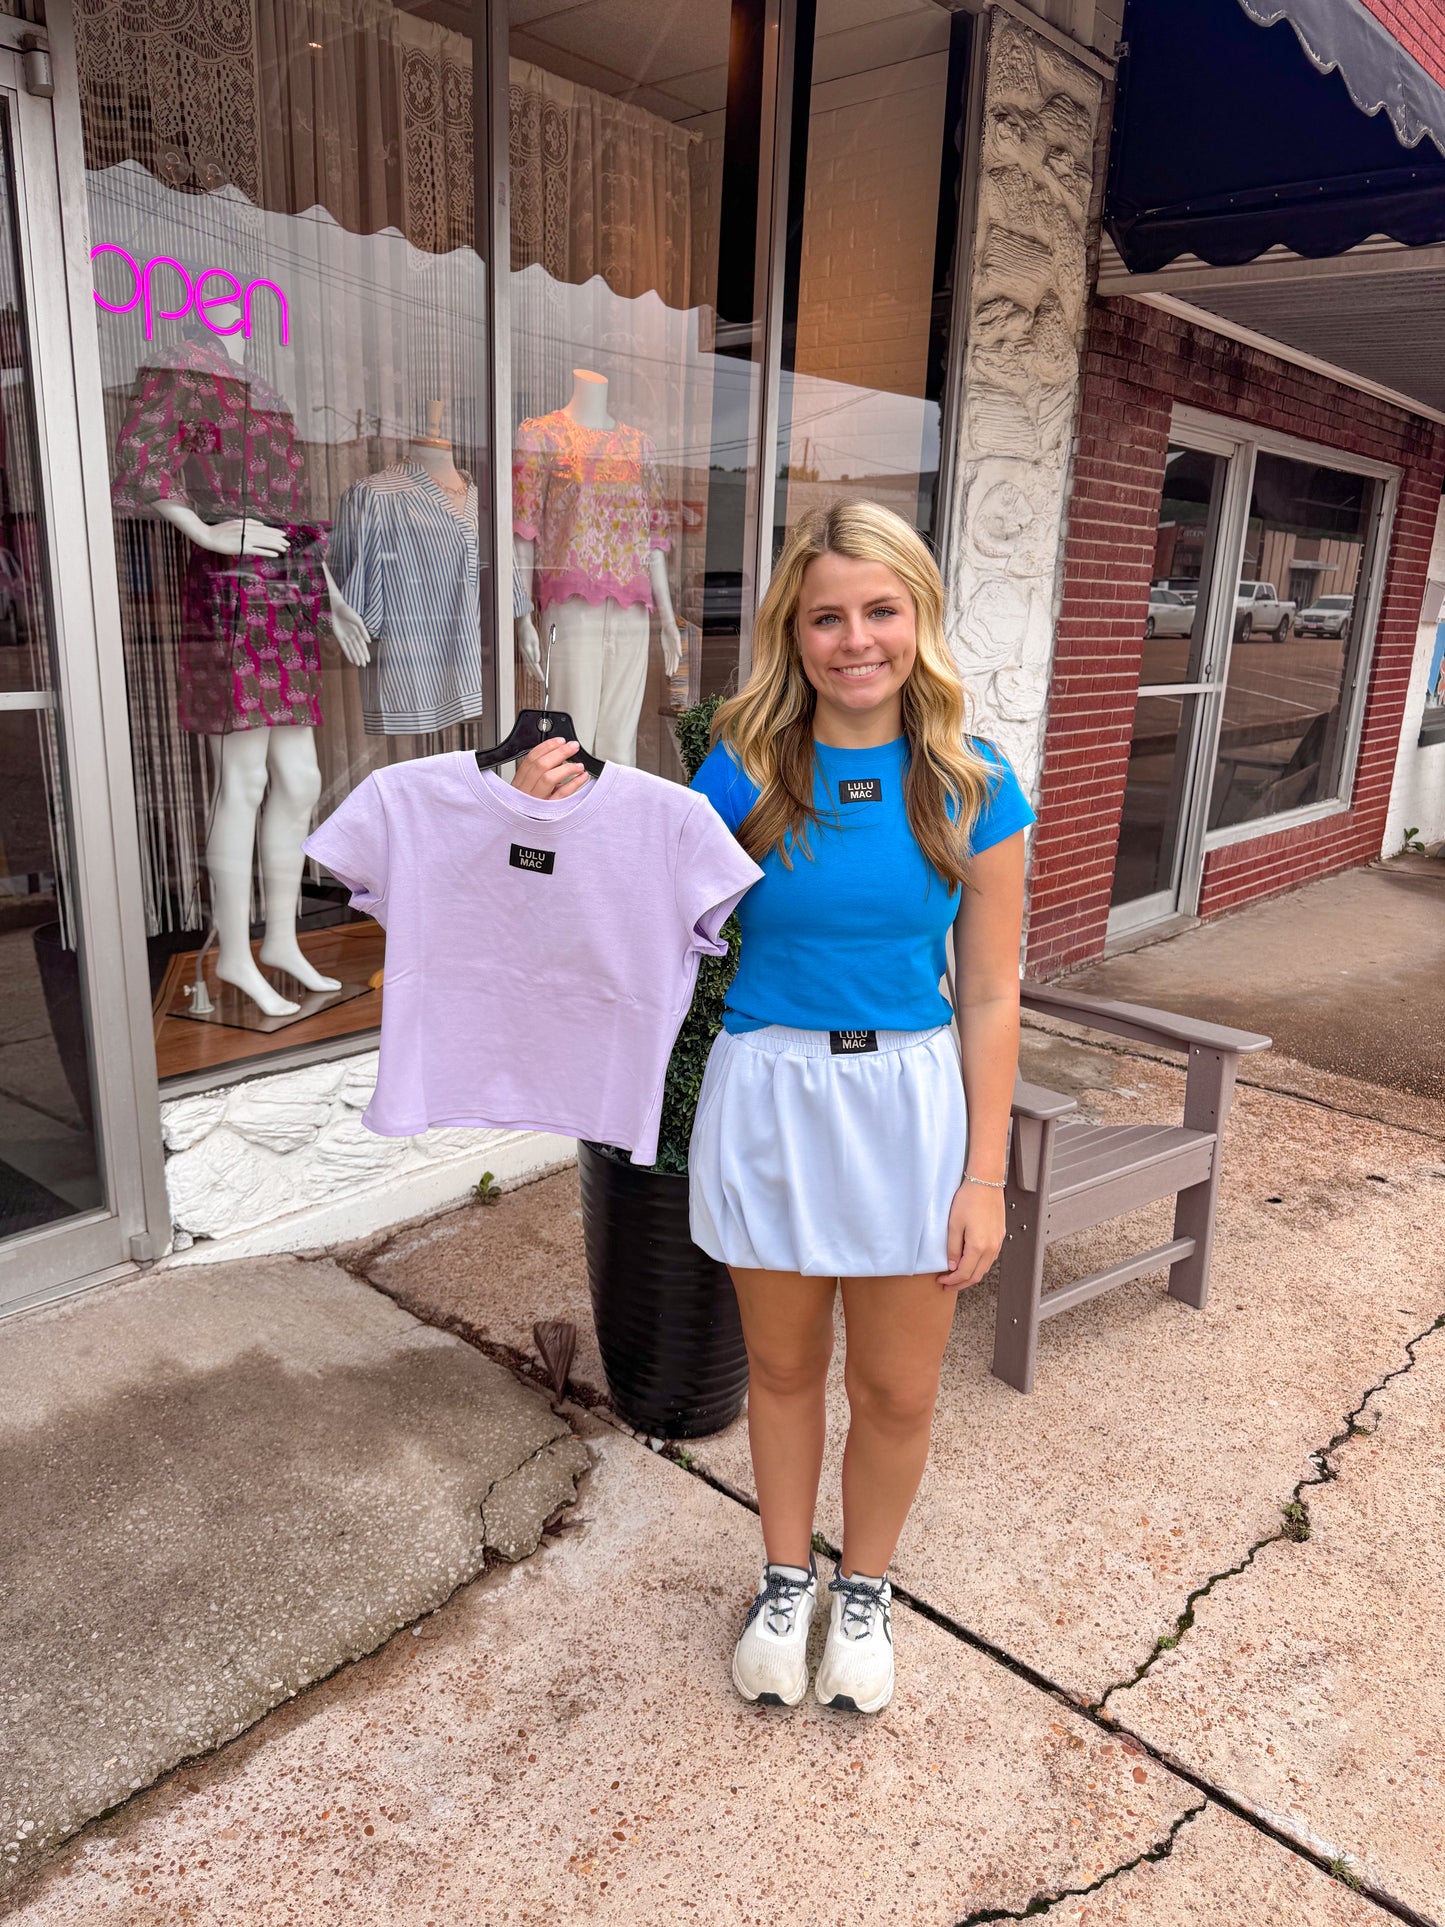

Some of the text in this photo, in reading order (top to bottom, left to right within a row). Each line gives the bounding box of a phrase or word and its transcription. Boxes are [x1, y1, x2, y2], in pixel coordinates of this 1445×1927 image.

[90, 243, 289, 346] open
[847, 781, 874, 791] LULU
[850, 790, 873, 799] MAC
[519, 848, 546, 861] LULU
[520, 857, 543, 869] MAC
[839, 1030, 868, 1039] LULU
[842, 1038, 867, 1049] MAC
